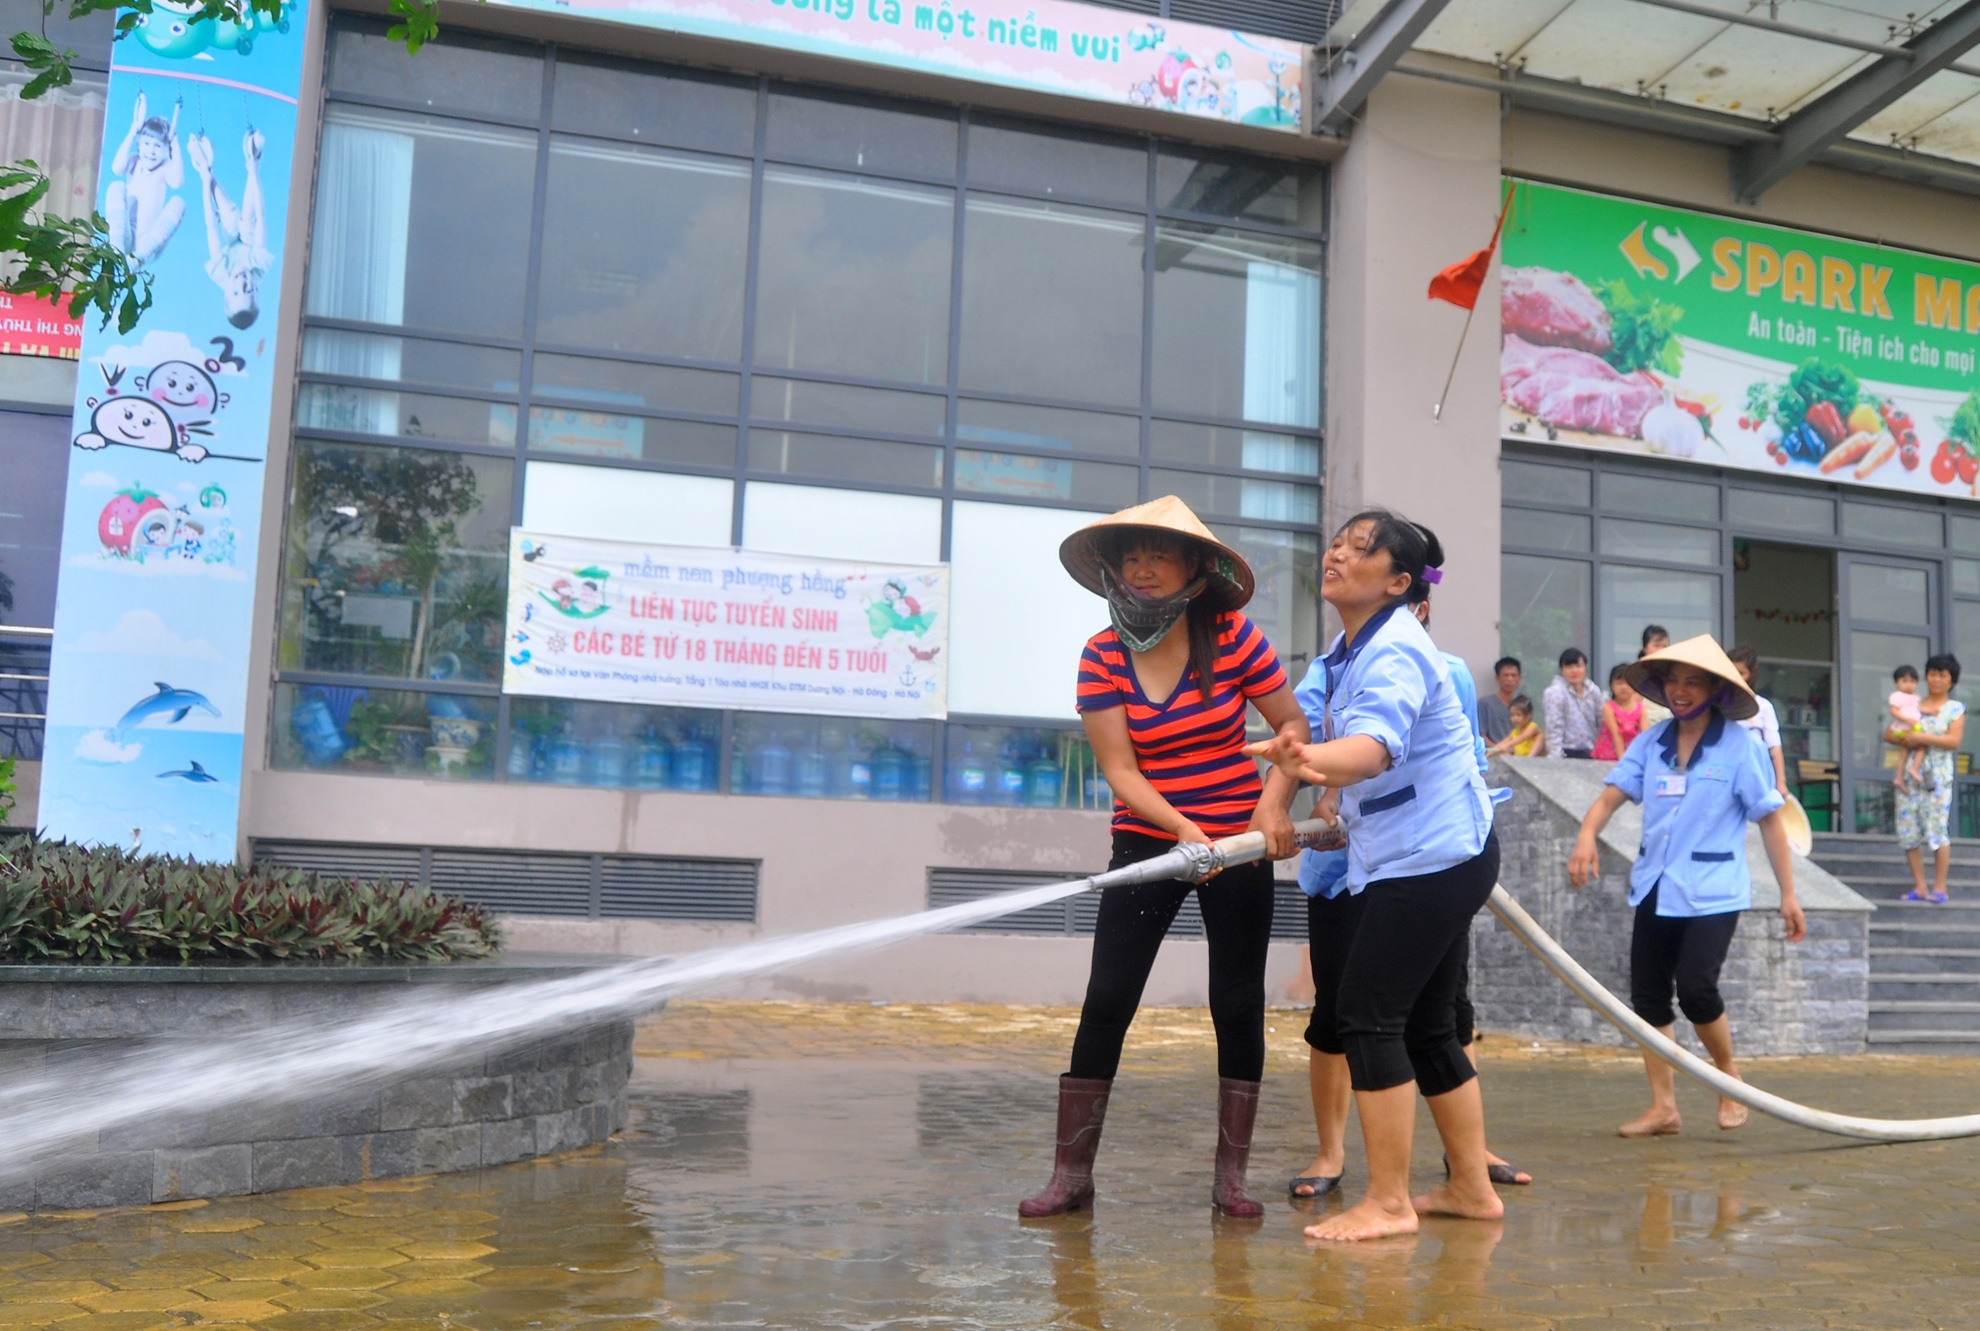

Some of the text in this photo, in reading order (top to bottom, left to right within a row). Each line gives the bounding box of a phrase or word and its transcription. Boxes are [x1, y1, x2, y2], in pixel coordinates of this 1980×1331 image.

[914, 1, 975, 40] một
[987, 9, 1058, 52] niềm
[1071, 32, 1120, 63] vui
[1711, 236, 1894, 320] SPARK
[37, 318, 59, 335] THỊ
[1748, 311, 1771, 339] An
[1777, 317, 1817, 346] toàn
[1836, 325, 1873, 359] Tiện
[1879, 334, 1904, 361] ích
[1909, 341, 1940, 368] cho
[1945, 348, 1975, 377] mọi
[623, 554, 670, 580] mầm
[722, 567, 793, 595] phượng
[801, 569, 847, 599] hồng
[630, 591, 674, 621] LIÊN
[682, 599, 717, 628] TỤC
[792, 608, 838, 632] SINH
[573, 626, 613, 656] CÁC
[620, 628, 645, 657] BÉ
[654, 632, 679, 660] TỪ
[684, 639, 706, 661] 18
[713, 633, 776, 666] THÁNG
[783, 638, 822, 670] ĐẾN
[828, 650, 839, 670] 5
